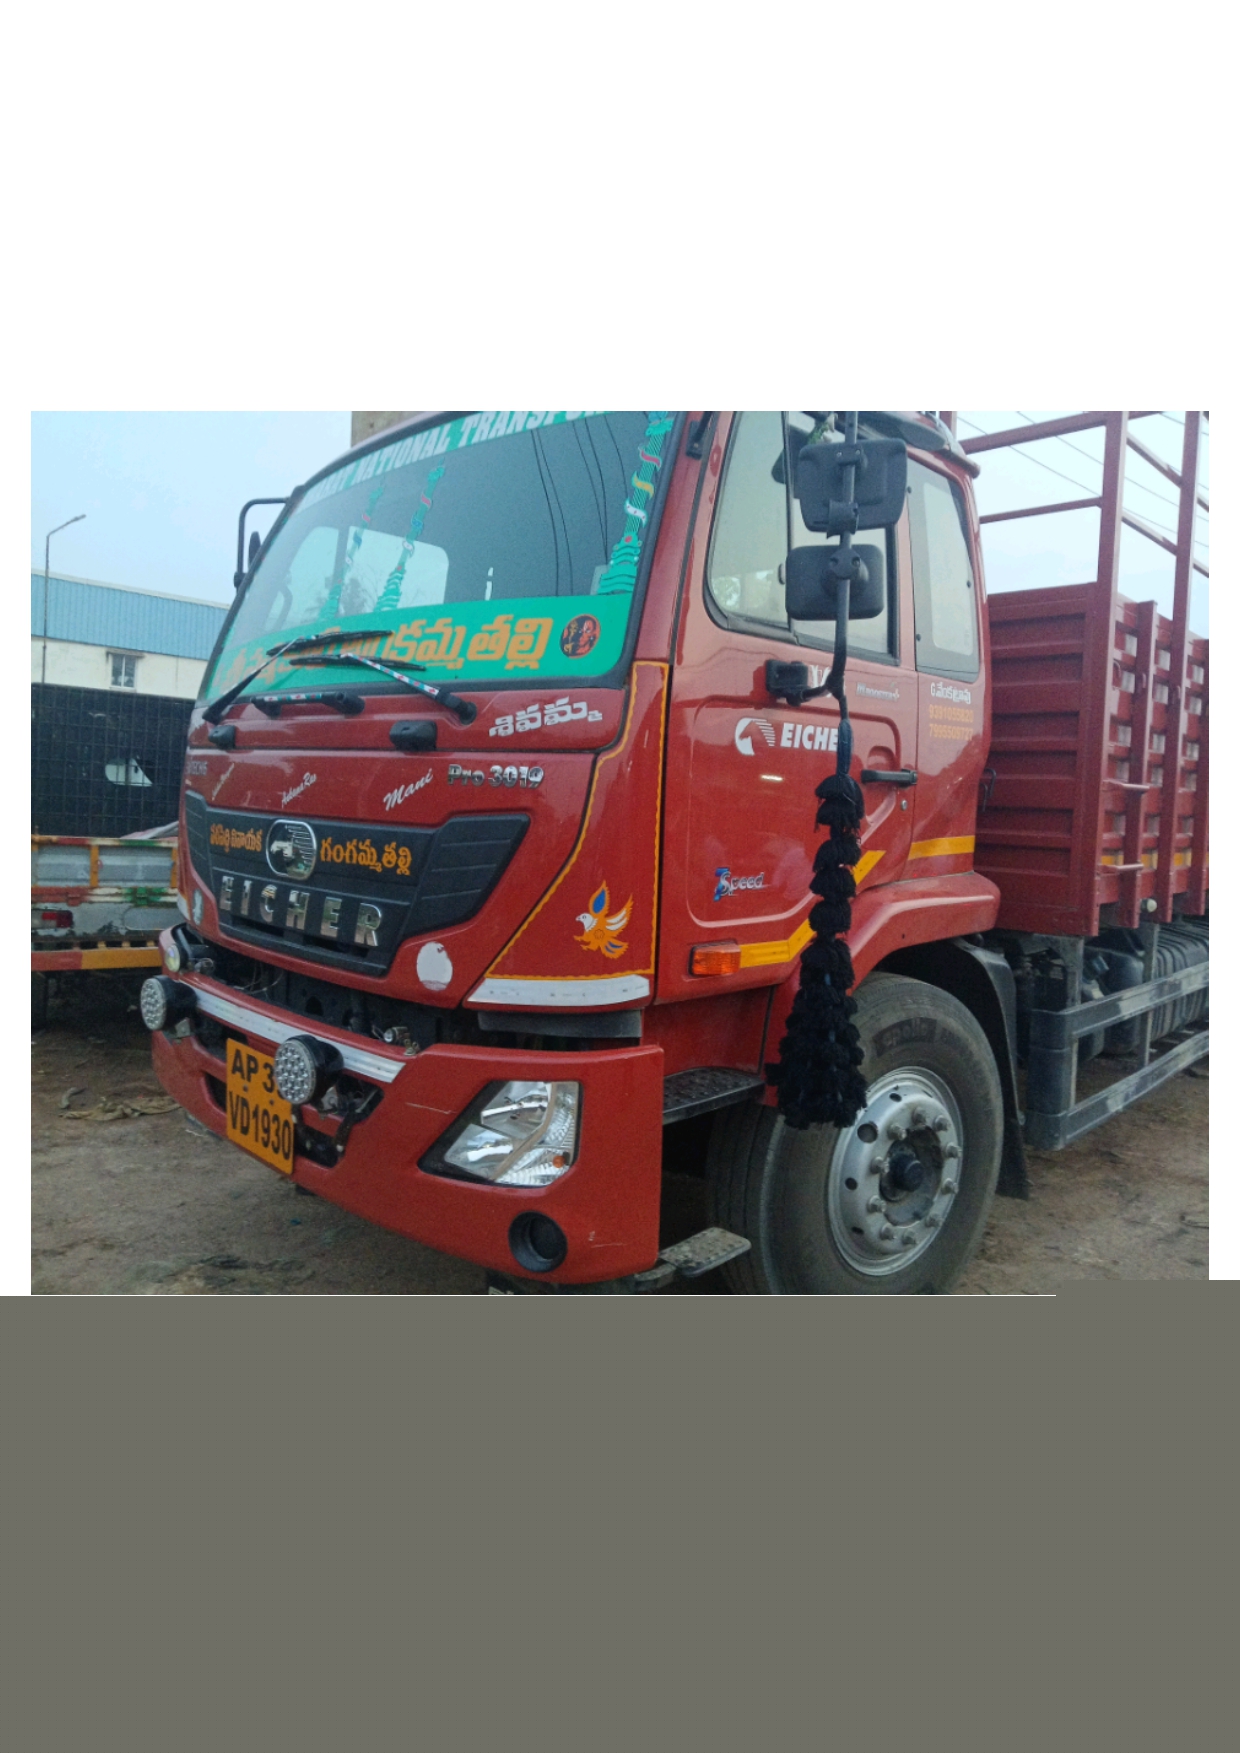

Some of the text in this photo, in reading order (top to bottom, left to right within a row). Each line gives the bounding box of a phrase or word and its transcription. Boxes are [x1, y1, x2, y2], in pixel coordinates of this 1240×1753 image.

[352, 421, 452, 486] NATIONAL
[458, 411, 606, 449] TRANS
[780, 722, 839, 752] EICHE
[383, 768, 433, 811] Mani
[447, 763, 544, 789] Pro 3019
[218, 875, 383, 947] EICHER
[231, 1048, 285, 1100] AP 3
[228, 1090, 293, 1161] VD1930
